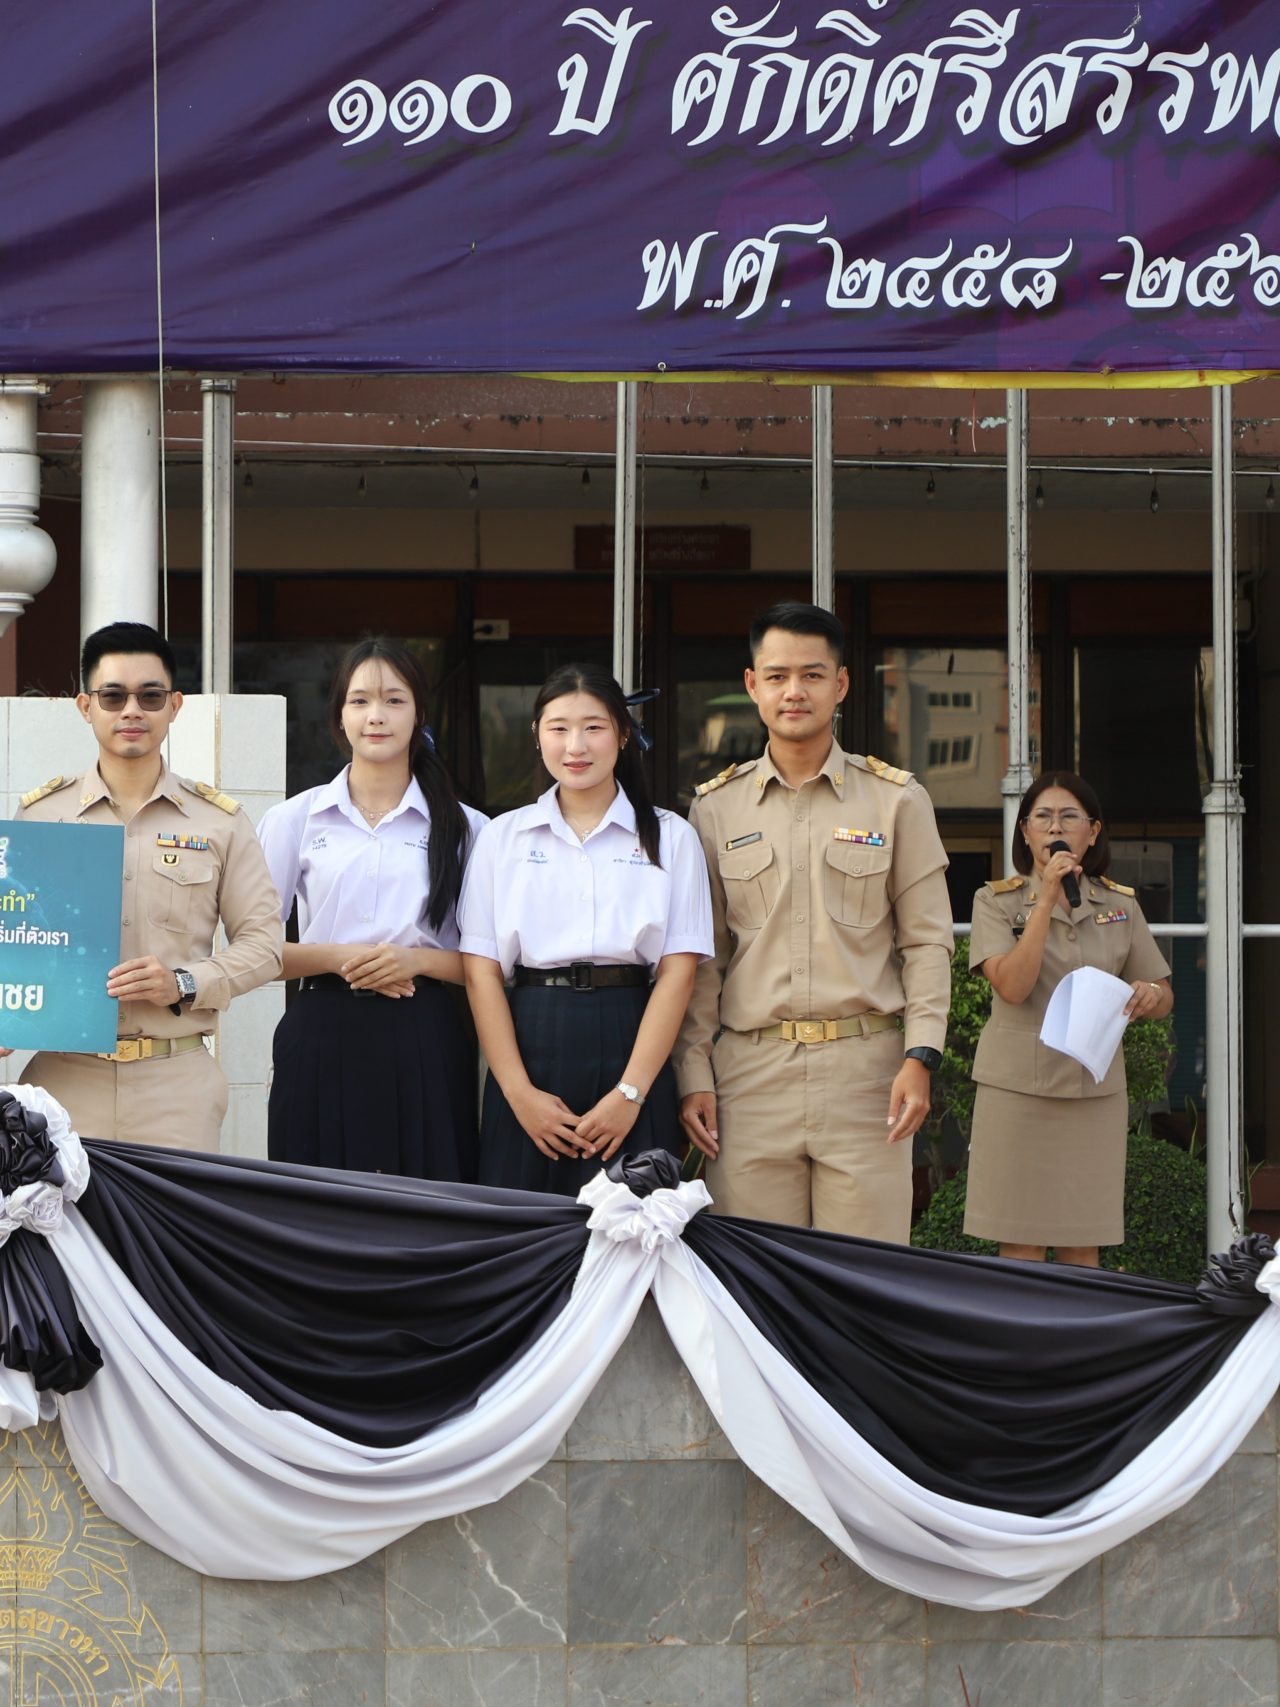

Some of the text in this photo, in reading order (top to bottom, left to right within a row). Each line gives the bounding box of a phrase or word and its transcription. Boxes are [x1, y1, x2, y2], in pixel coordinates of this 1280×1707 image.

[328, 0, 1280, 147] ๑๑๐ ปี ศักดิศรีสรรพ
